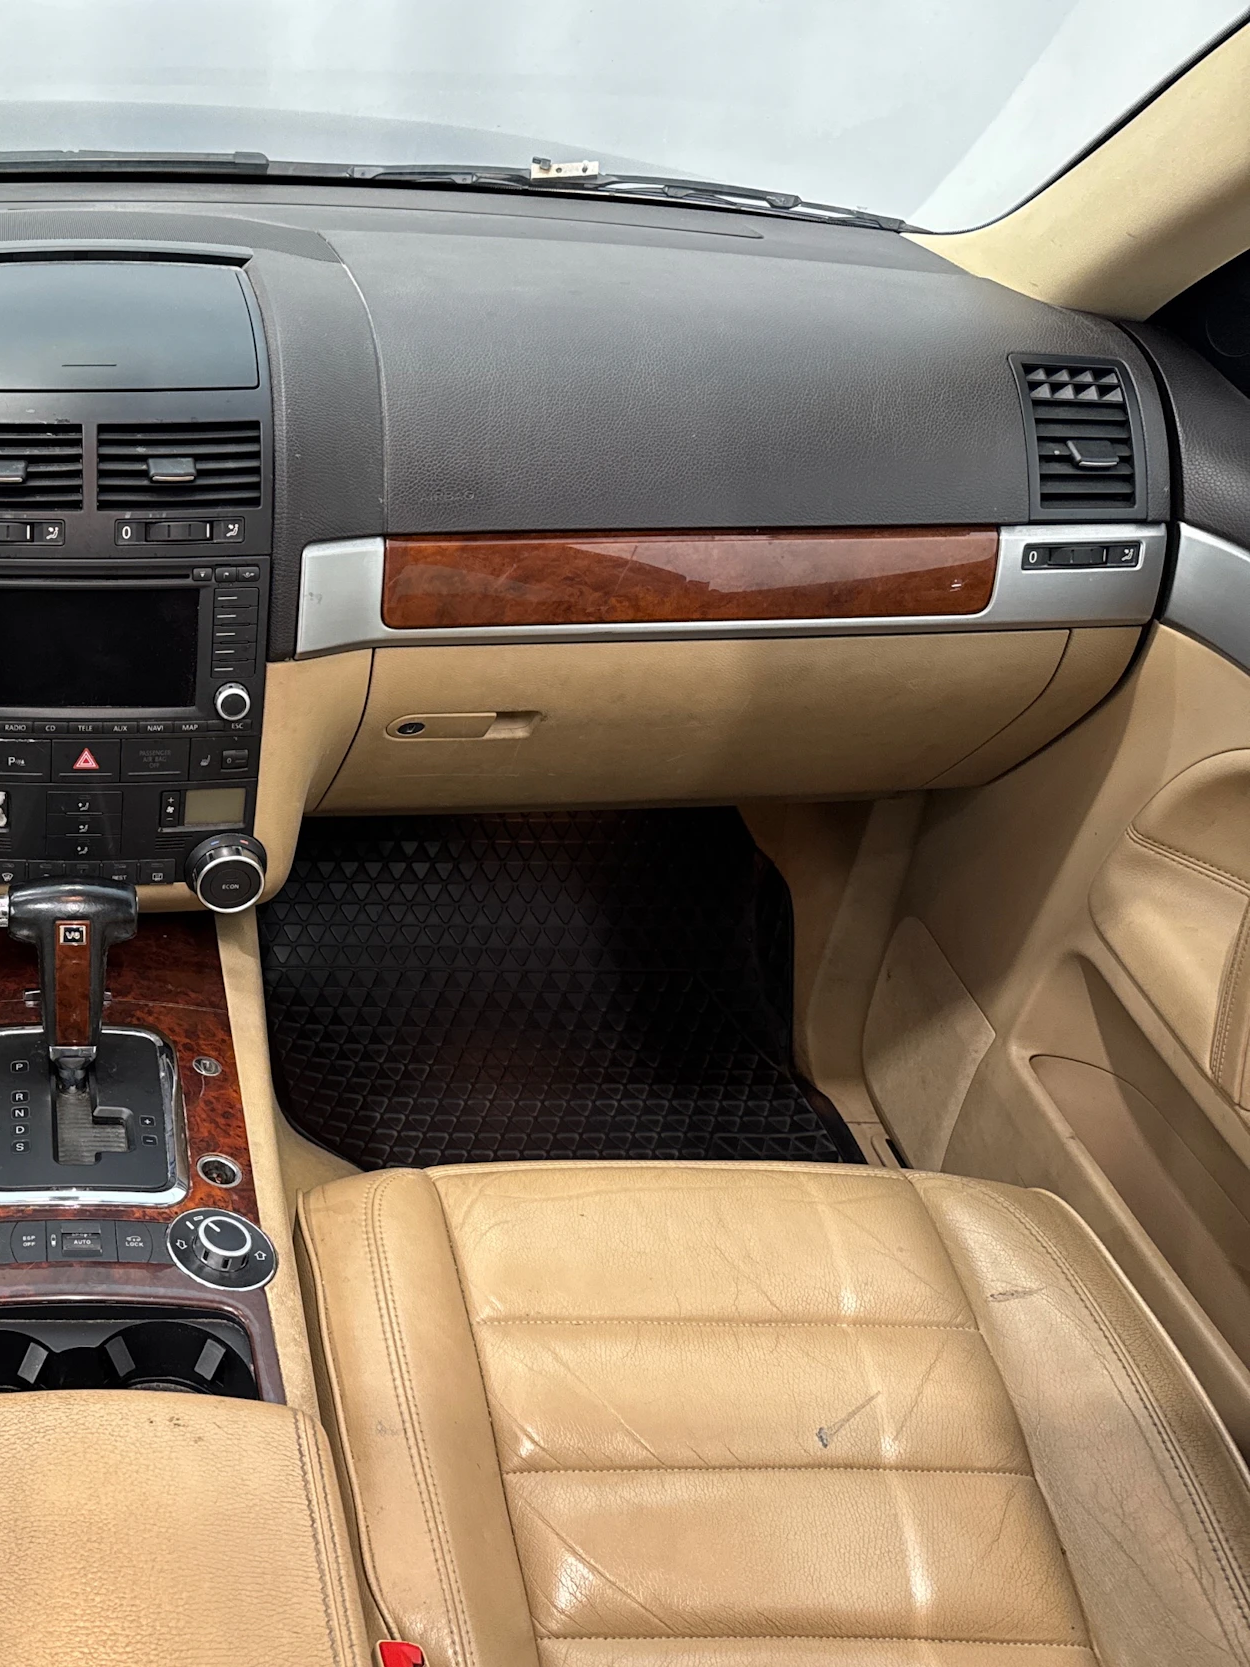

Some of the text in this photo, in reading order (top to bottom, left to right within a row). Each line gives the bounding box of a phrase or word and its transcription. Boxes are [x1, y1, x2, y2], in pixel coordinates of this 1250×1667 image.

[121, 525, 132, 540] 0
[1028, 550, 1038, 564] 0
[231, 721, 244, 730] ESC
[15, 1093, 23, 1101] R
[15, 1109, 24, 1117] N
[15, 1126, 25, 1134] D
[15, 1142, 24, 1151] S
